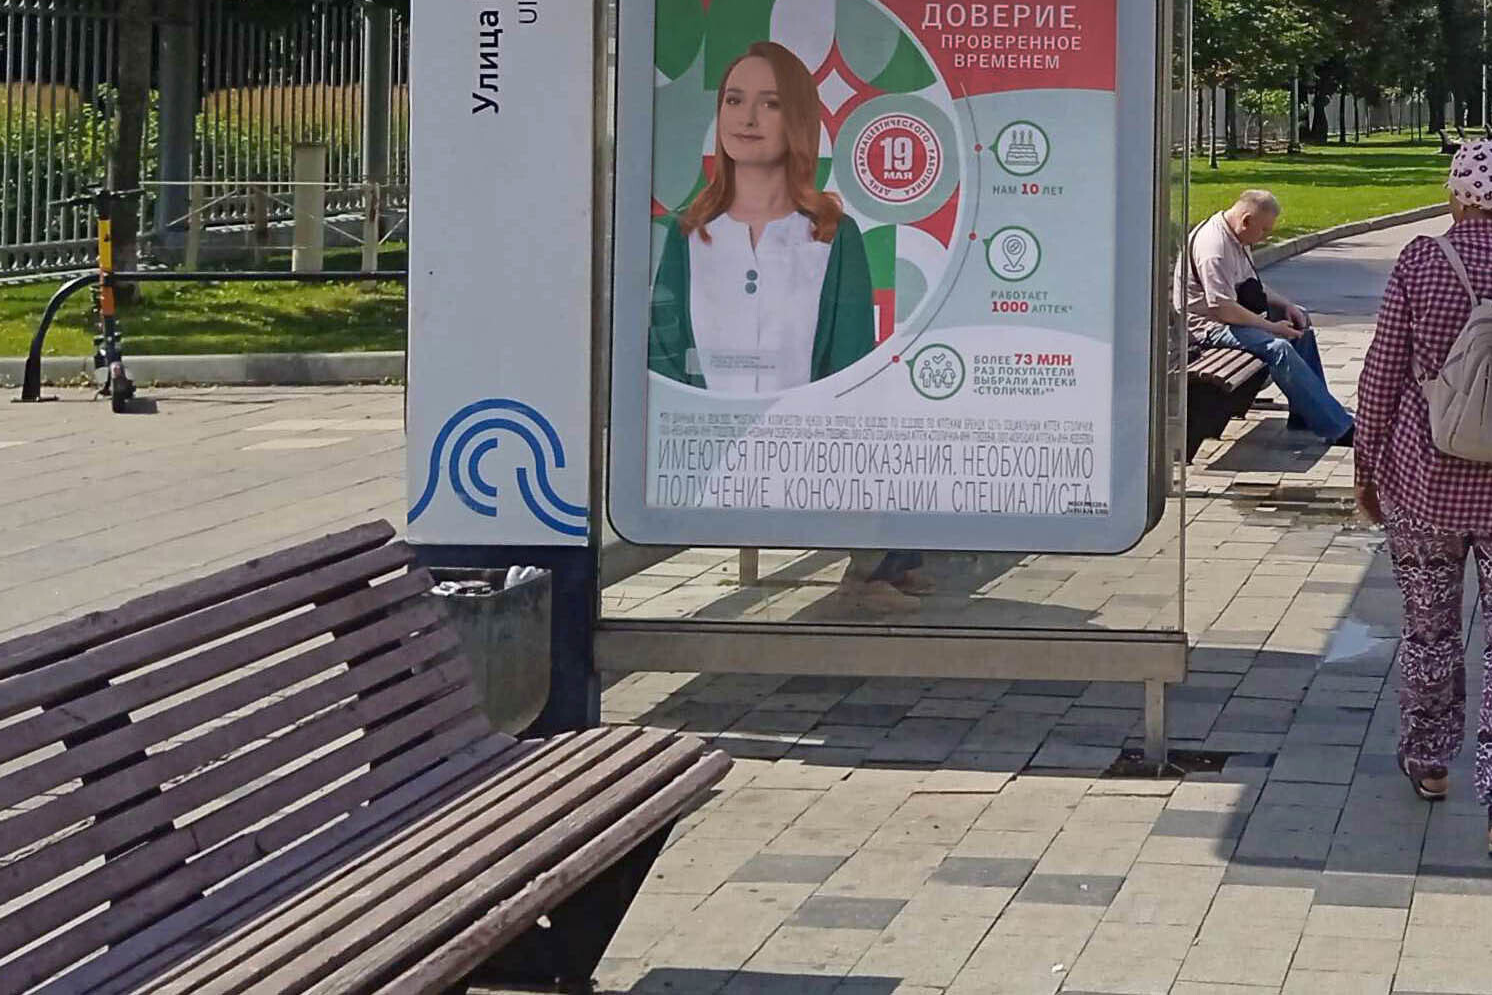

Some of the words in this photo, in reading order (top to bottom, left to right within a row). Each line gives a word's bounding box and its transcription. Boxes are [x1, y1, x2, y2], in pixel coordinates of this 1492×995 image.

[921, 3, 1083, 31] ДОВЕРИЕ,
[940, 33, 1082, 51] ПРОВЕРЕННОЕ
[472, 9, 503, 114] Улица
[953, 54, 1060, 69] ВРЕМЕНЕМ
[880, 136, 913, 171] 19
[883, 171, 913, 181] МАЯ
[992, 185, 1017, 196] НАМ
[1021, 183, 1040, 195] 10
[1042, 185, 1065, 196] ЛЕТ
[990, 290, 1049, 301] РАБОТАЕТ
[991, 301, 1030, 313] 1000
[973, 355, 1011, 365] БОЛЕЕ
[1014, 353, 1033, 365] 73
[1037, 354, 1072, 366] МЛН
[973, 366, 996, 376] РАЗ
[998, 366, 1075, 377] ПОКУПАТЕЛИ
[973, 376, 1029, 386] ВЫБРАЛИ
[1031, 377, 1077, 387] АПТЕКИ
[657, 438, 748, 472] ИМЕЮТСЯ
[753, 441, 957, 476] ПРОТИВОПОКАЗАНИЯ.
[963, 445, 1094, 480] НЕОБХОДИМО
[656, 474, 771, 509] ПОЛУЧЕНИЕ
[784, 477, 938, 511] КОНСУЛЬТАЦИИ
[951, 481, 1093, 514] СПЕЦИАЛИСТА
